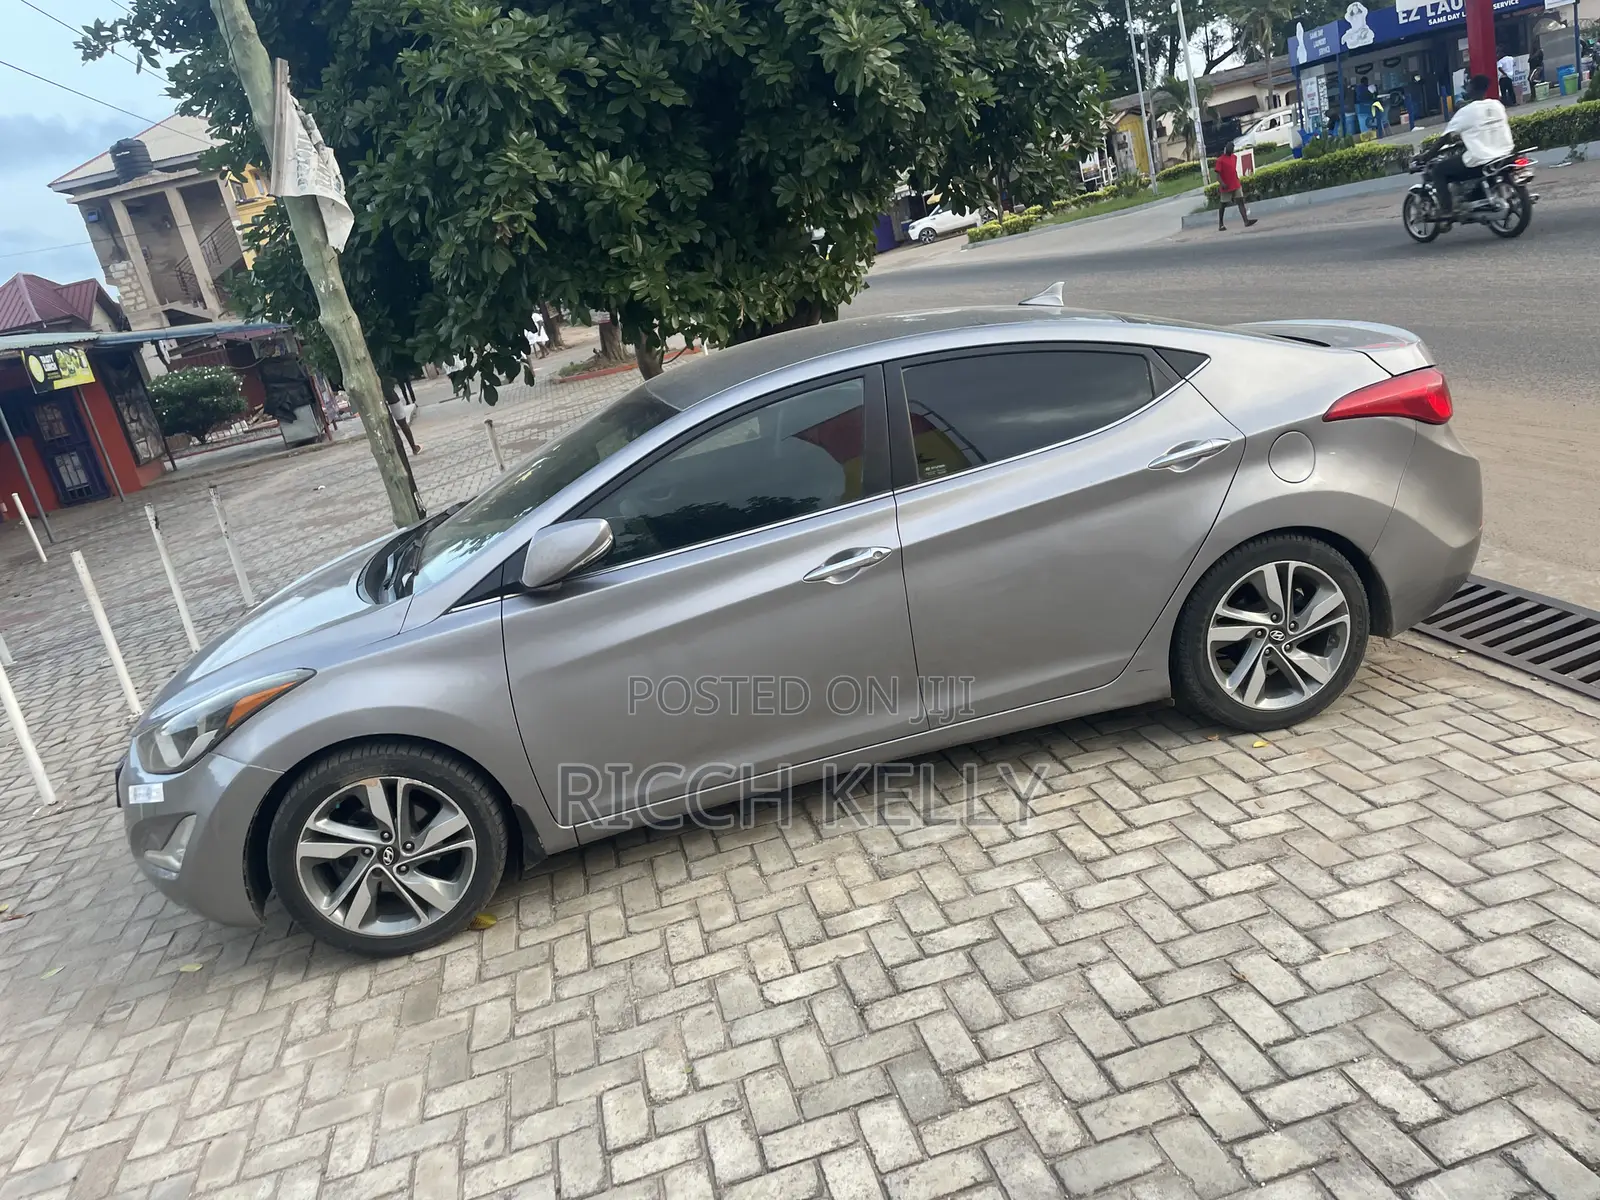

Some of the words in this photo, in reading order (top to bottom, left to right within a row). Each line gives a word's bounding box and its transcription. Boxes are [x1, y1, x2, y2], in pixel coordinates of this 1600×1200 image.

[1398, 6, 1420, 24] EZ
[1426, 0, 1466, 17] LAU
[1428, 15, 1447, 25] SAME
[1447, 12, 1460, 21] DAY
[1492, 0, 1519, 10] SERVICE
